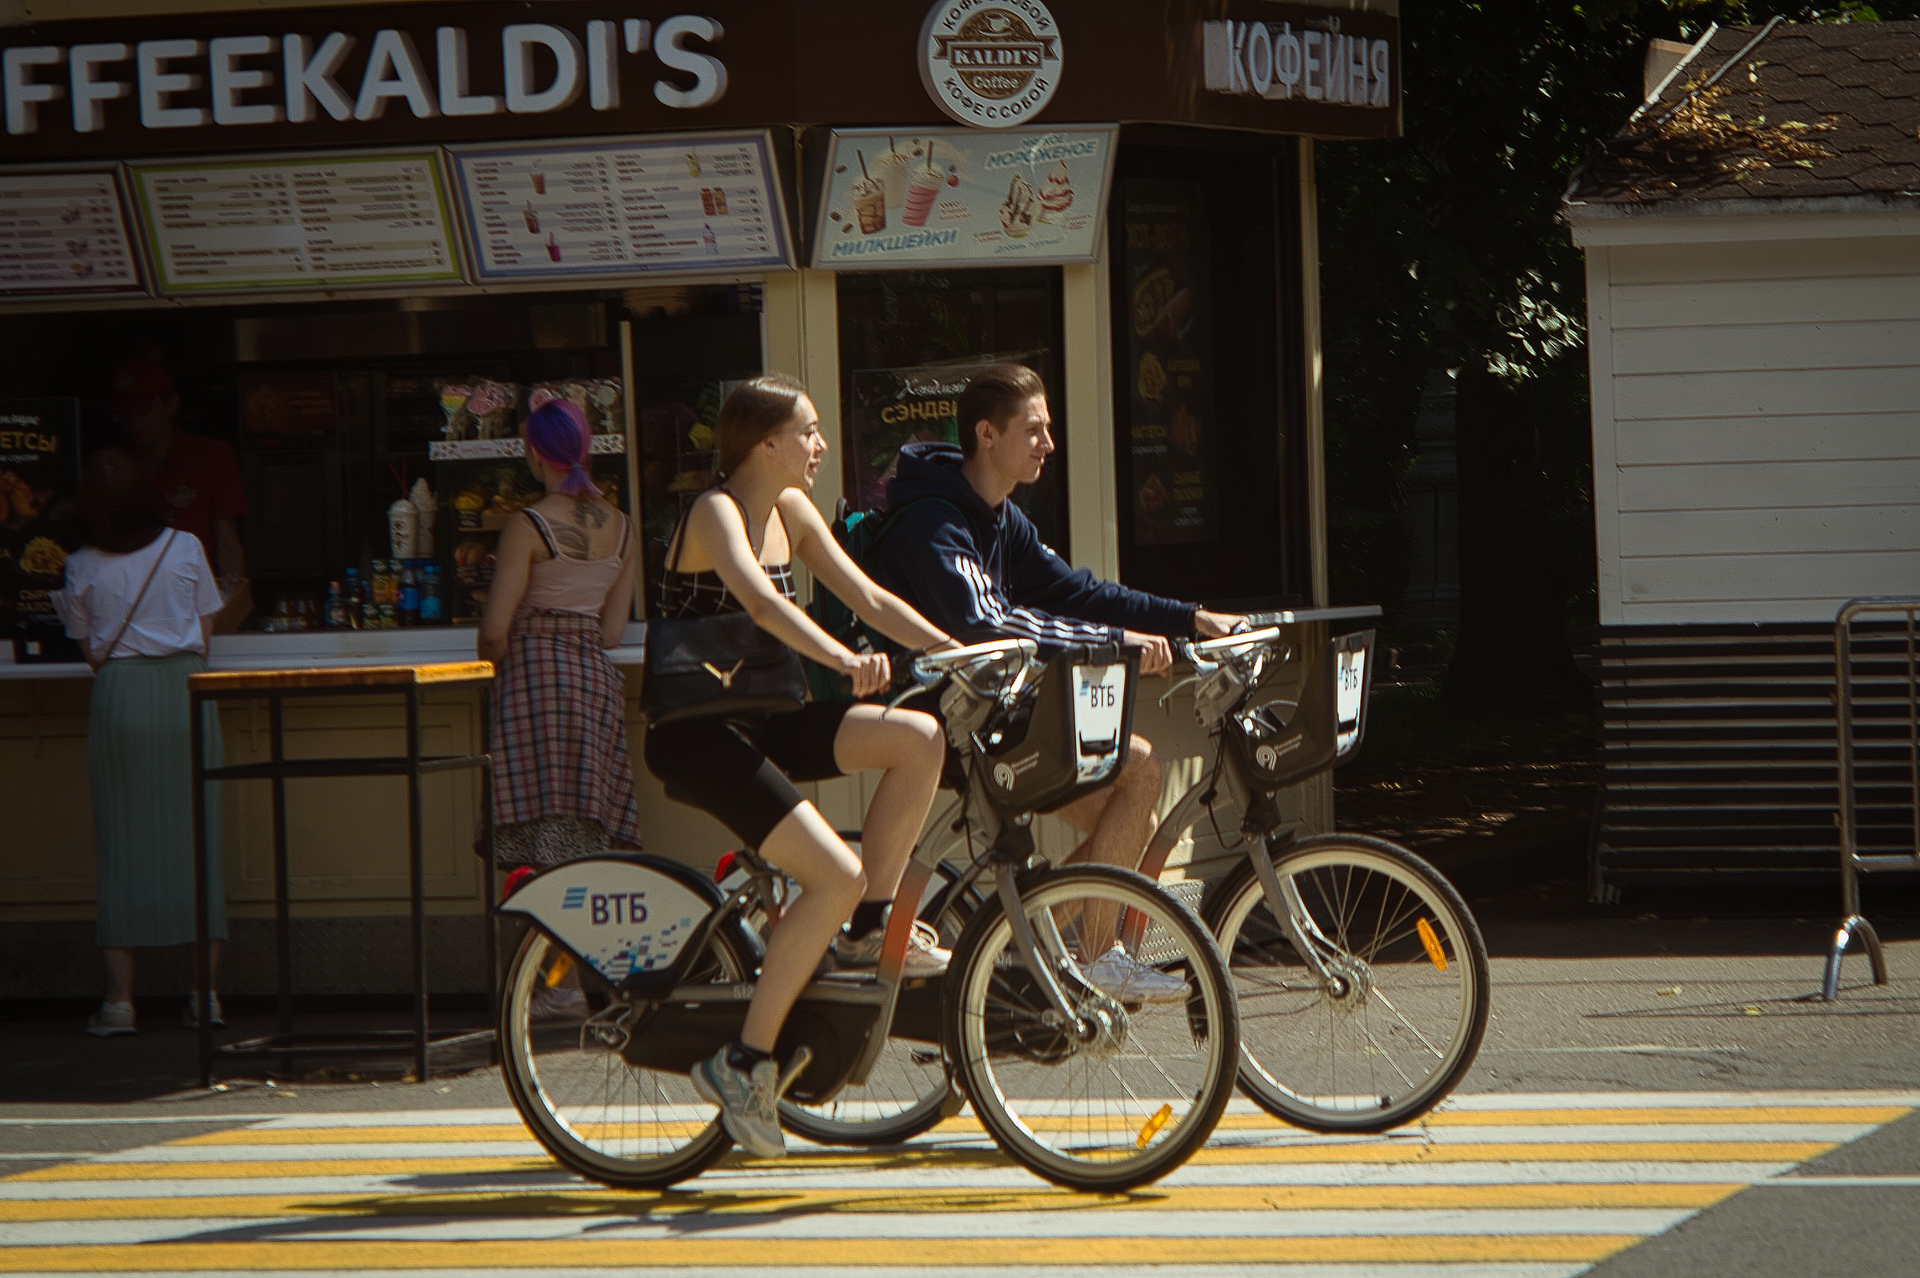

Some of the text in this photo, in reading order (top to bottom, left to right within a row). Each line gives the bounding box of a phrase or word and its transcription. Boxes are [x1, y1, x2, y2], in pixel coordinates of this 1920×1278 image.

[953, 49, 1039, 65] KALDI'S
[1222, 14, 1391, 108] КОФЕЙНЯ
[972, 74, 1019, 90] Coffee
[943, 77, 1049, 118] КОФЕССОВОЙ
[832, 228, 958, 256] МИЛКШЕЙКИ
[1090, 685, 1116, 708] ВТБ
[590, 891, 648, 926] ВТБ
